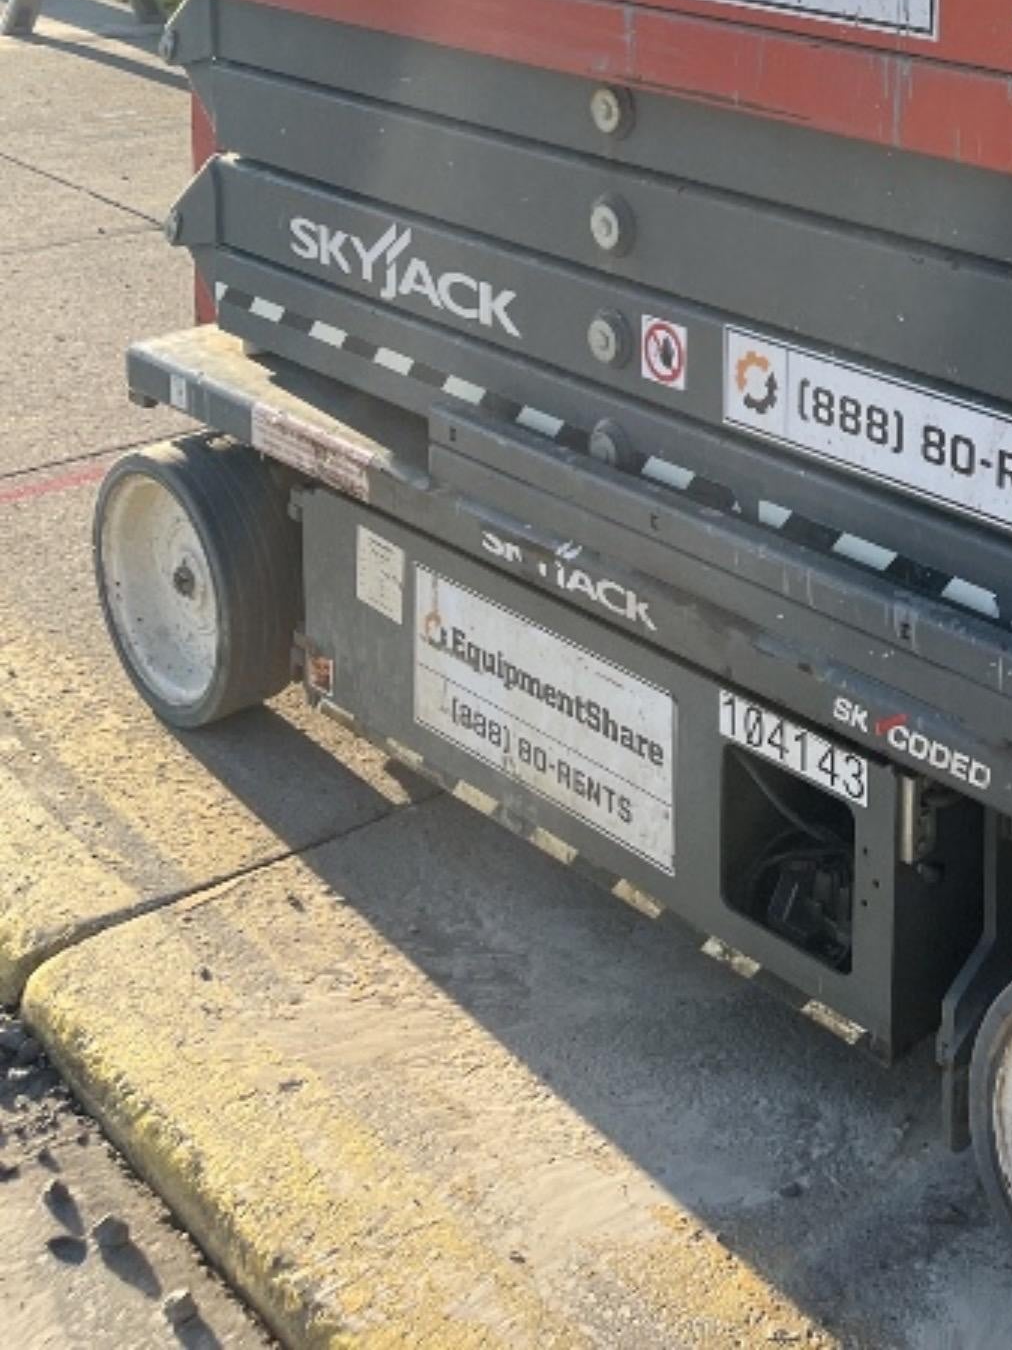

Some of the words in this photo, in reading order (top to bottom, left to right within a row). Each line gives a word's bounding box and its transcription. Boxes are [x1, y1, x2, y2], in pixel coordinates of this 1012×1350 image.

[289, 217, 522, 339] SKYJACK
[797, 377, 905, 454] (888)
[451, 626, 665, 768] EquipmentShare
[723, 697, 865, 799] 104143
[451, 697, 512, 754] (888)
[517, 737, 633, 825] 80-RENTS
